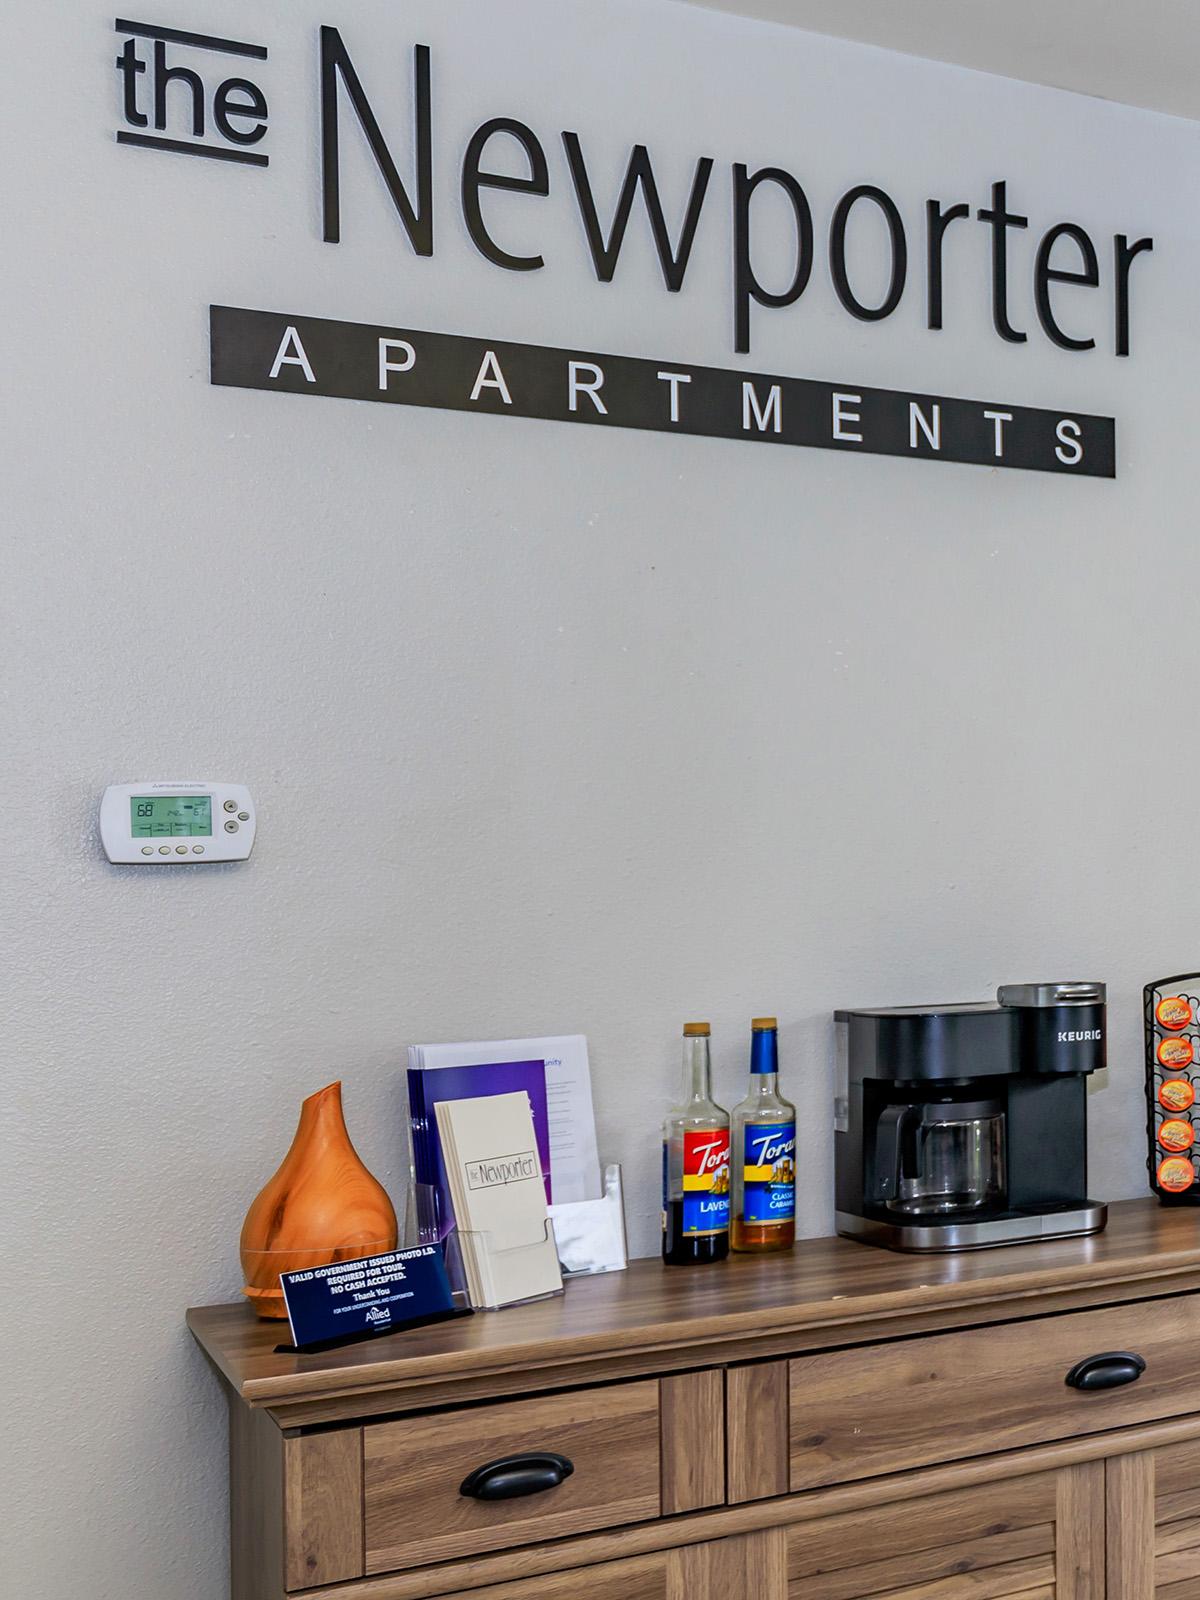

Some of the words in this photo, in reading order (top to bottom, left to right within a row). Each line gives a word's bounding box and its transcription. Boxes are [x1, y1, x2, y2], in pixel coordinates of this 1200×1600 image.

[116, 38, 269, 146] the
[319, 24, 1154, 358] Newporter
[267, 325, 1084, 466] APARTMENTS
[1057, 1029, 1101, 1042] KEURIG
[479, 1157, 533, 1186] Newporter
[289, 1273, 314, 1284] VALID
[314, 1260, 369, 1279] GOVERNMENT
[369, 1255, 396, 1268] ISSUED
[396, 1250, 421, 1262] PHOTO
[327, 1270, 366, 1286] REQUIRED
[366, 1267, 382, 1278] FOR
[330, 1284, 344, 1295] NO
[344, 1279, 366, 1292] CASH
[352, 1288, 376, 1302] Thank
[376, 1287, 391, 1297] You
[365, 1307, 391, 1323] Allied
